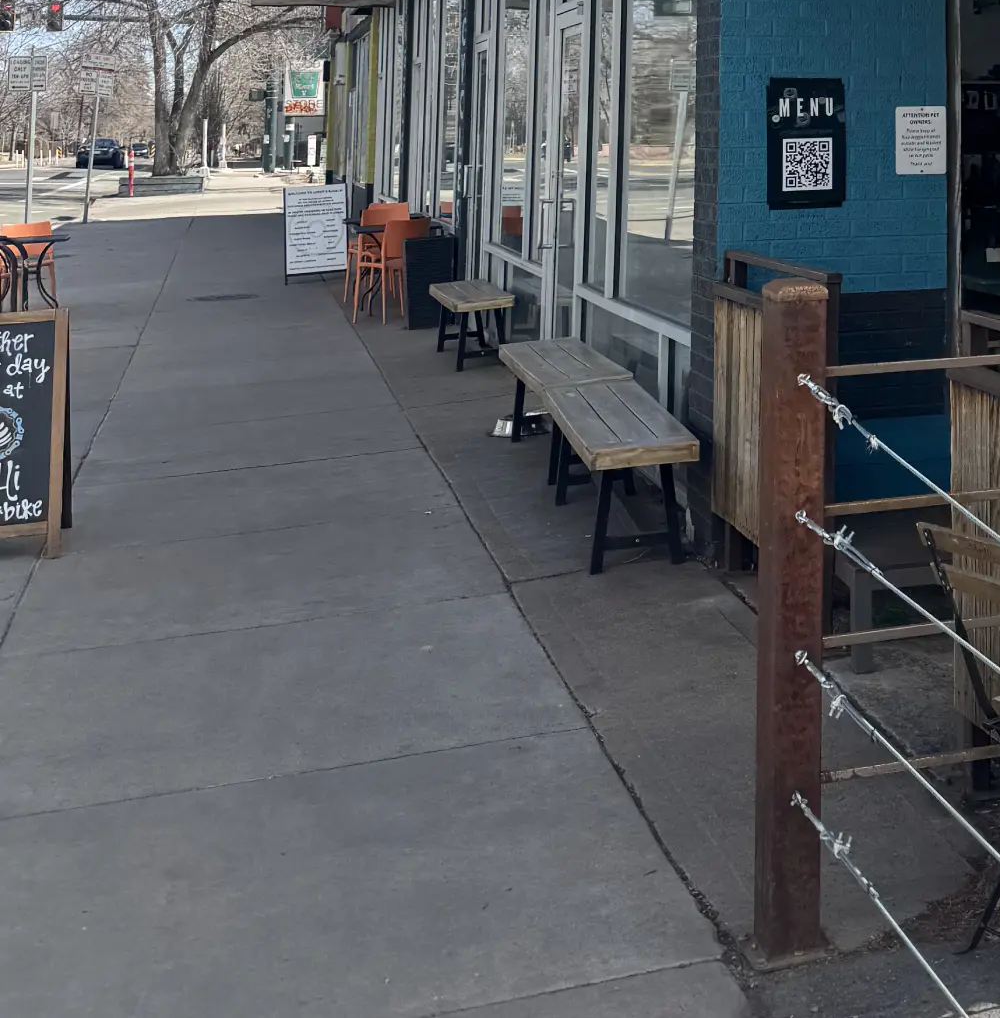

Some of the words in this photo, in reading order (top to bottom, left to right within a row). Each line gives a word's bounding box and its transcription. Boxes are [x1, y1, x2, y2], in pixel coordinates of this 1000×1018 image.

[778, 97, 834, 117] MENU
[0, 331, 34, 356] her
[6, 353, 50, 383] day
[3, 382, 24, 399] at
